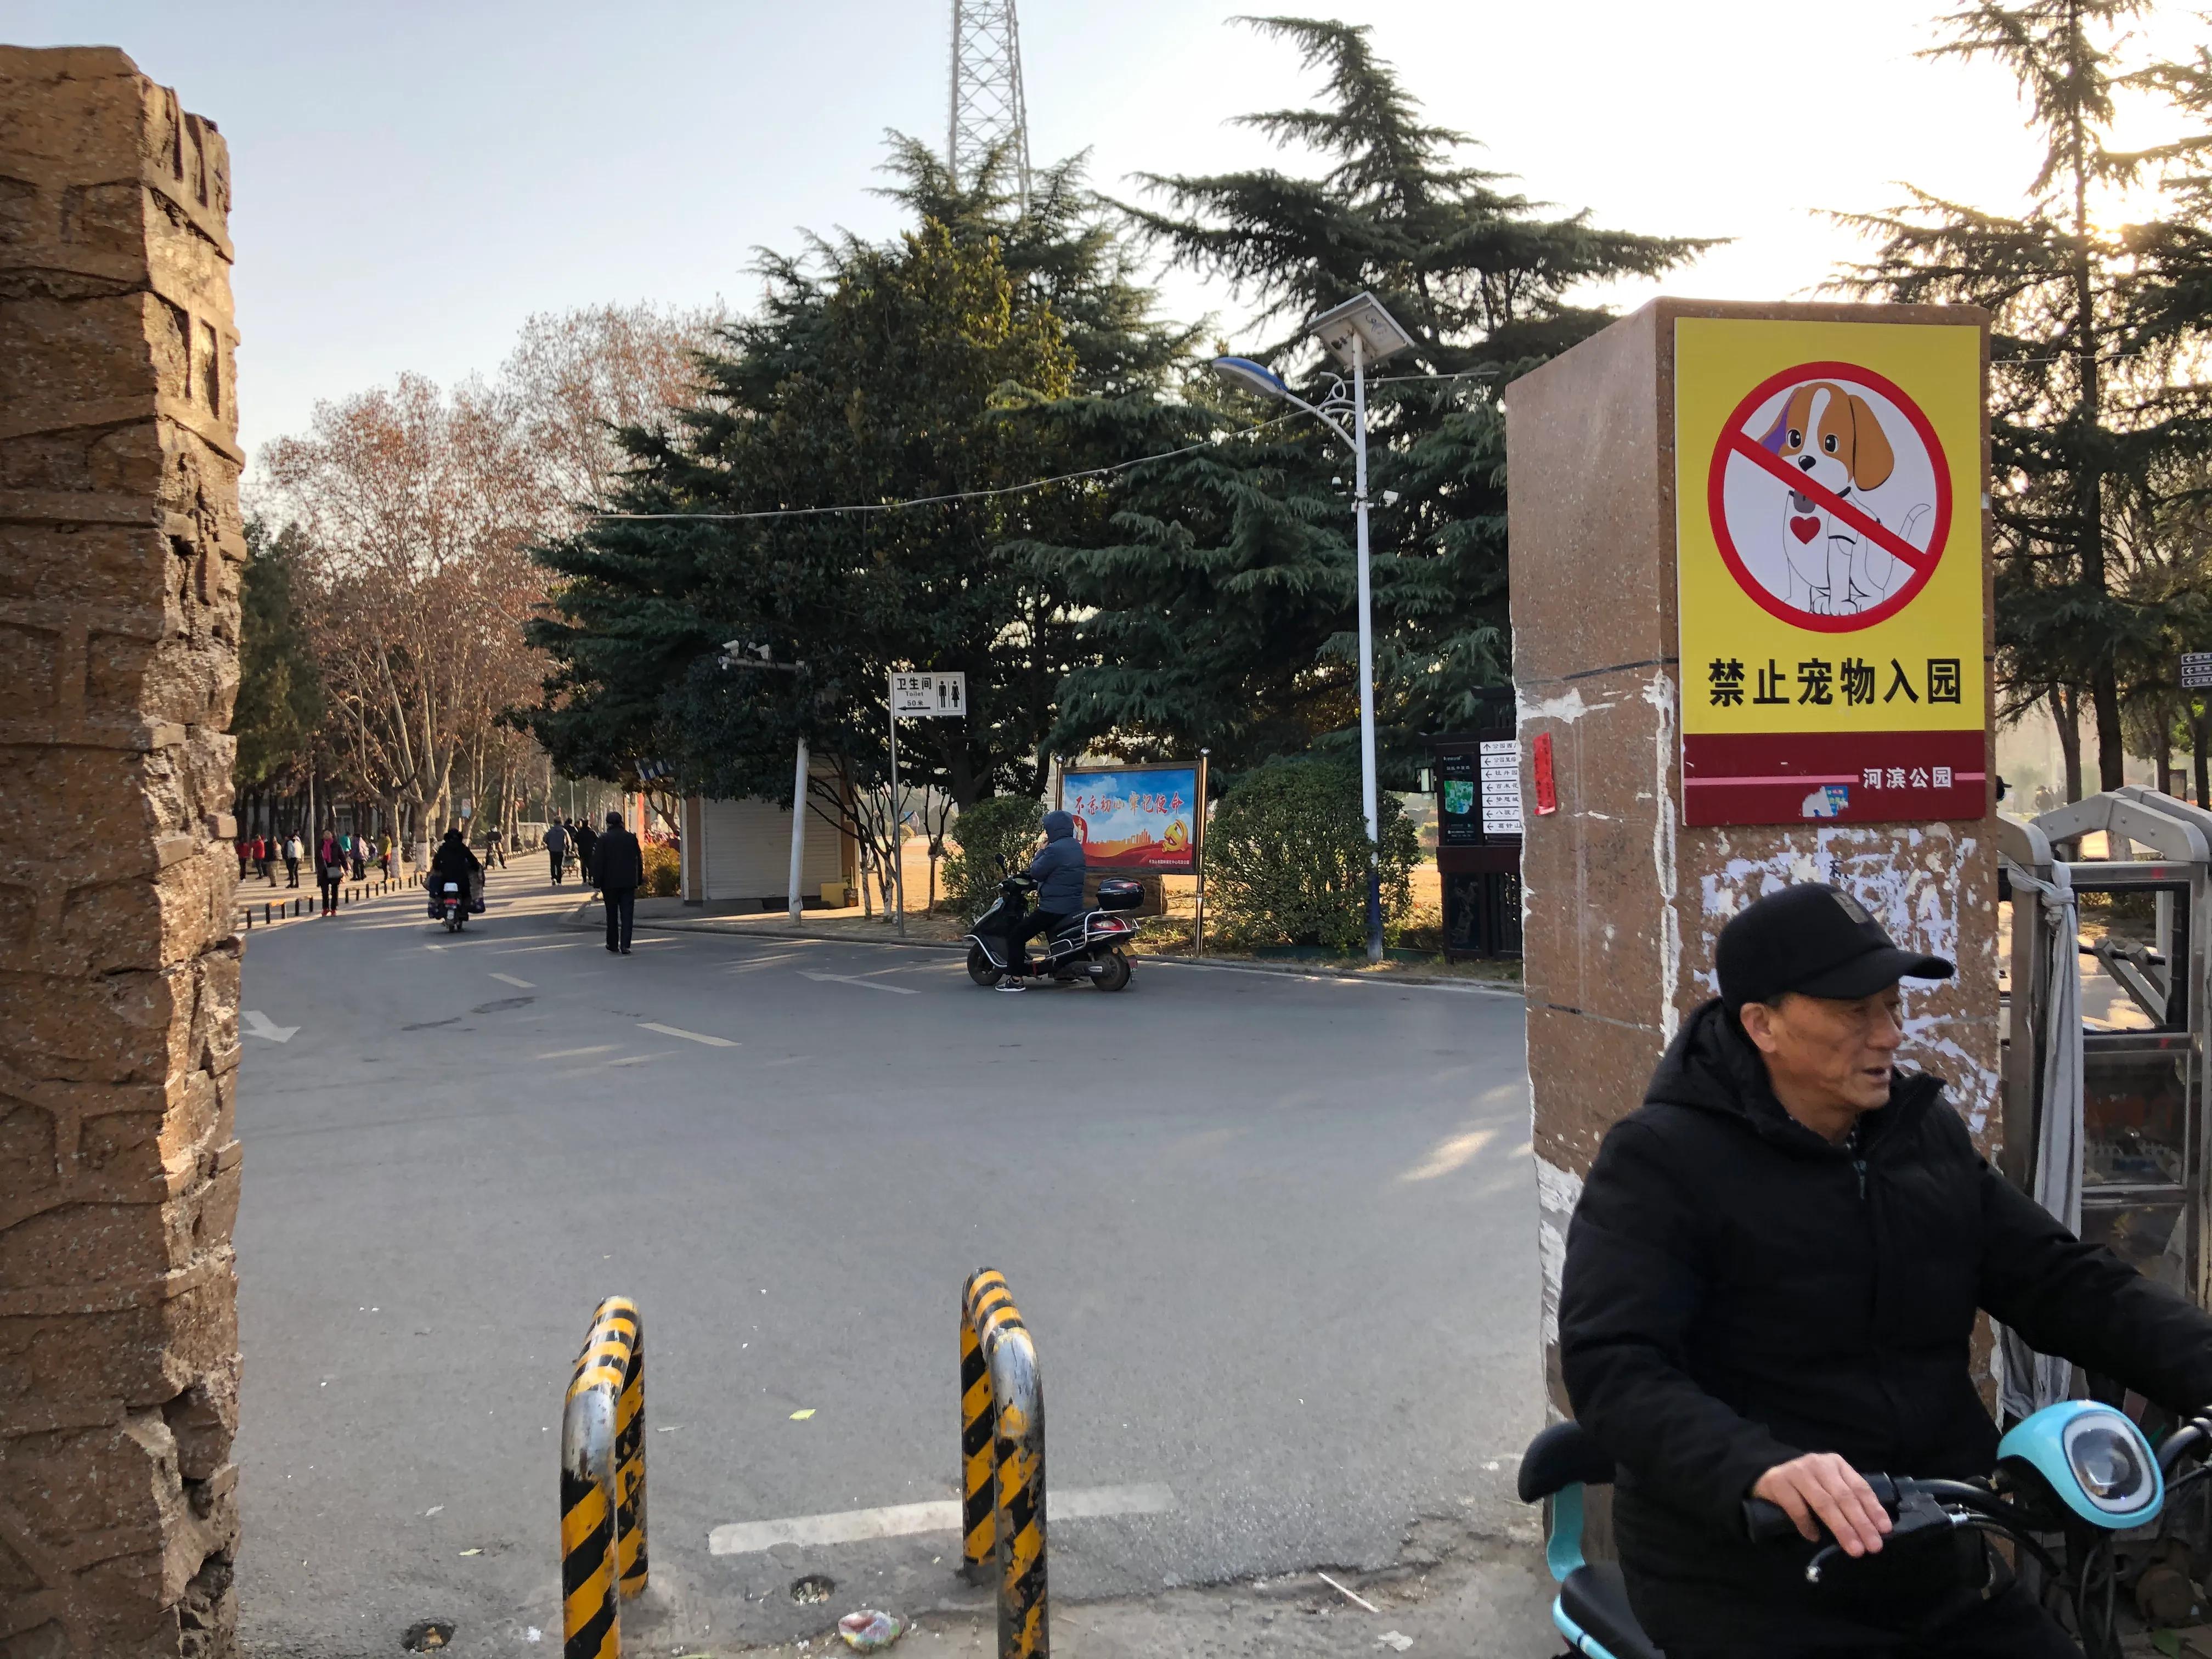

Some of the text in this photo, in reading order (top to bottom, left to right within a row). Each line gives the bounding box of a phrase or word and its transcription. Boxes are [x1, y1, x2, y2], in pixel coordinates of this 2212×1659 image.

[897, 677, 932, 690] 卫生间
[1708, 658, 1961, 707] 禁止宠物入园
[1863, 766, 1952, 789] 河滨公园
[1075, 791, 1183, 815] 不忘初心 牢记使命
